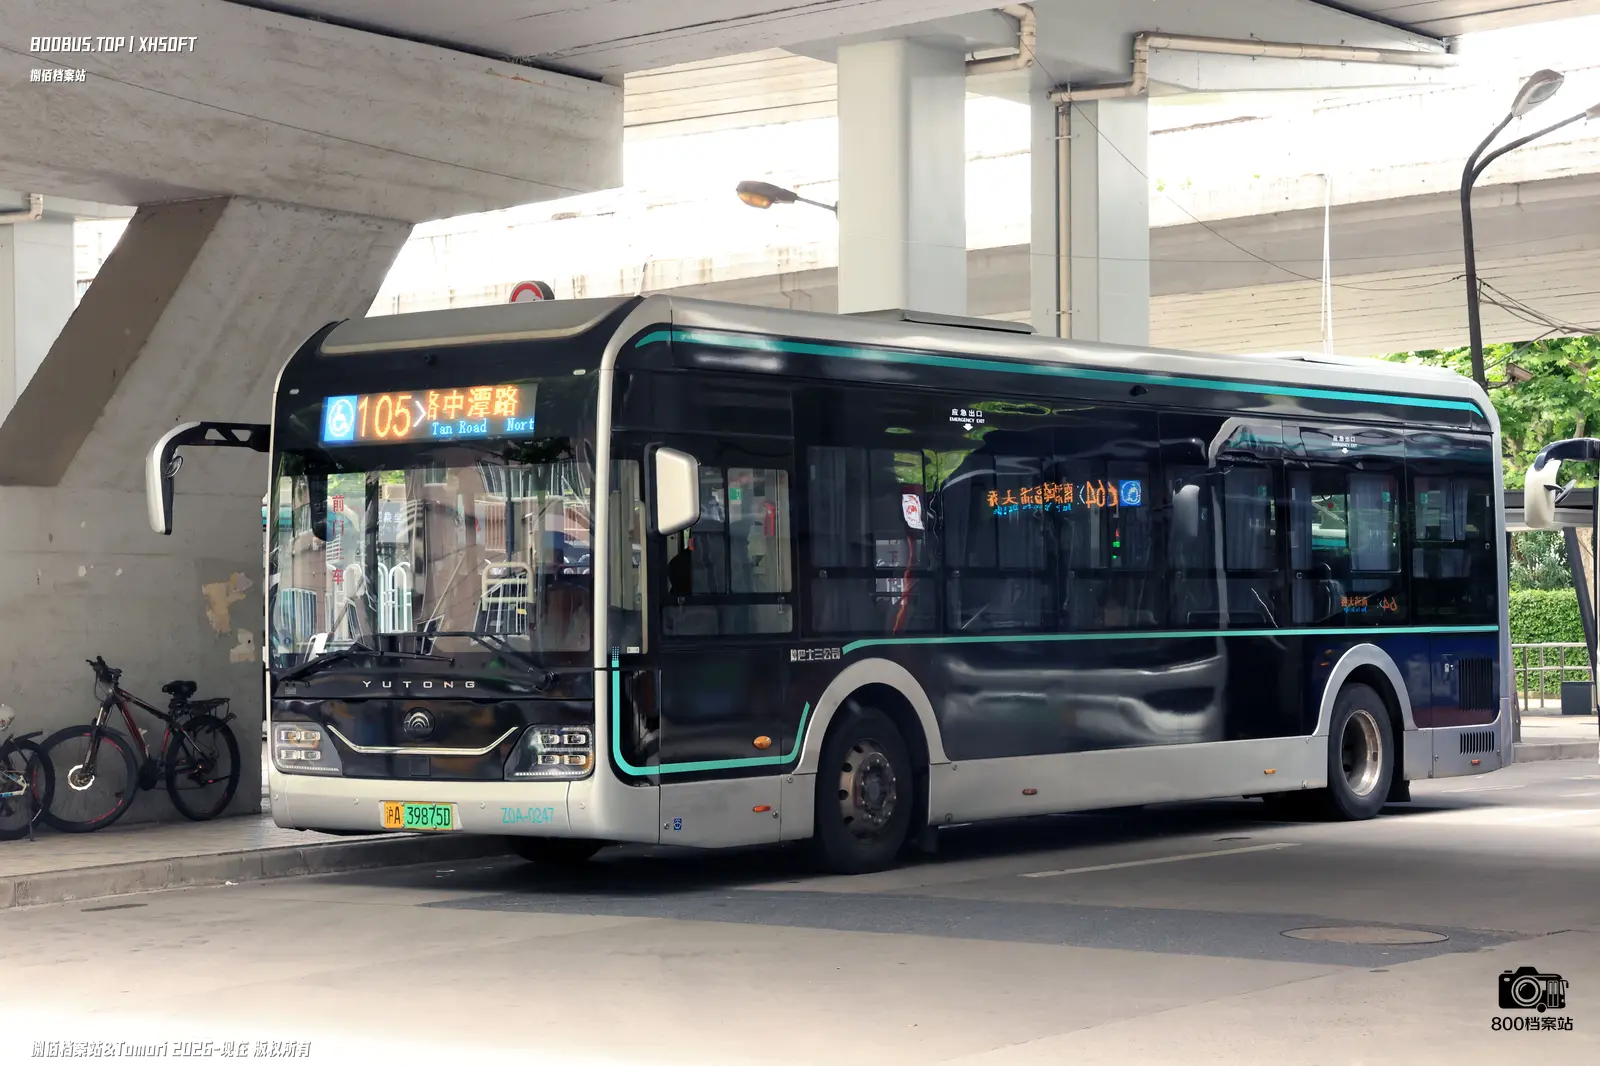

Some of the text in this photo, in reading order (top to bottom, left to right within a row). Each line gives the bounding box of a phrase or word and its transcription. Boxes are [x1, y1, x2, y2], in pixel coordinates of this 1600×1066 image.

[358, 394, 412, 437] 105
[951, 408, 983, 417] 应急出口
[432, 422, 453, 435] Tan
[459, 418, 487, 433] Road
[362, 680, 476, 689] YUTONG
